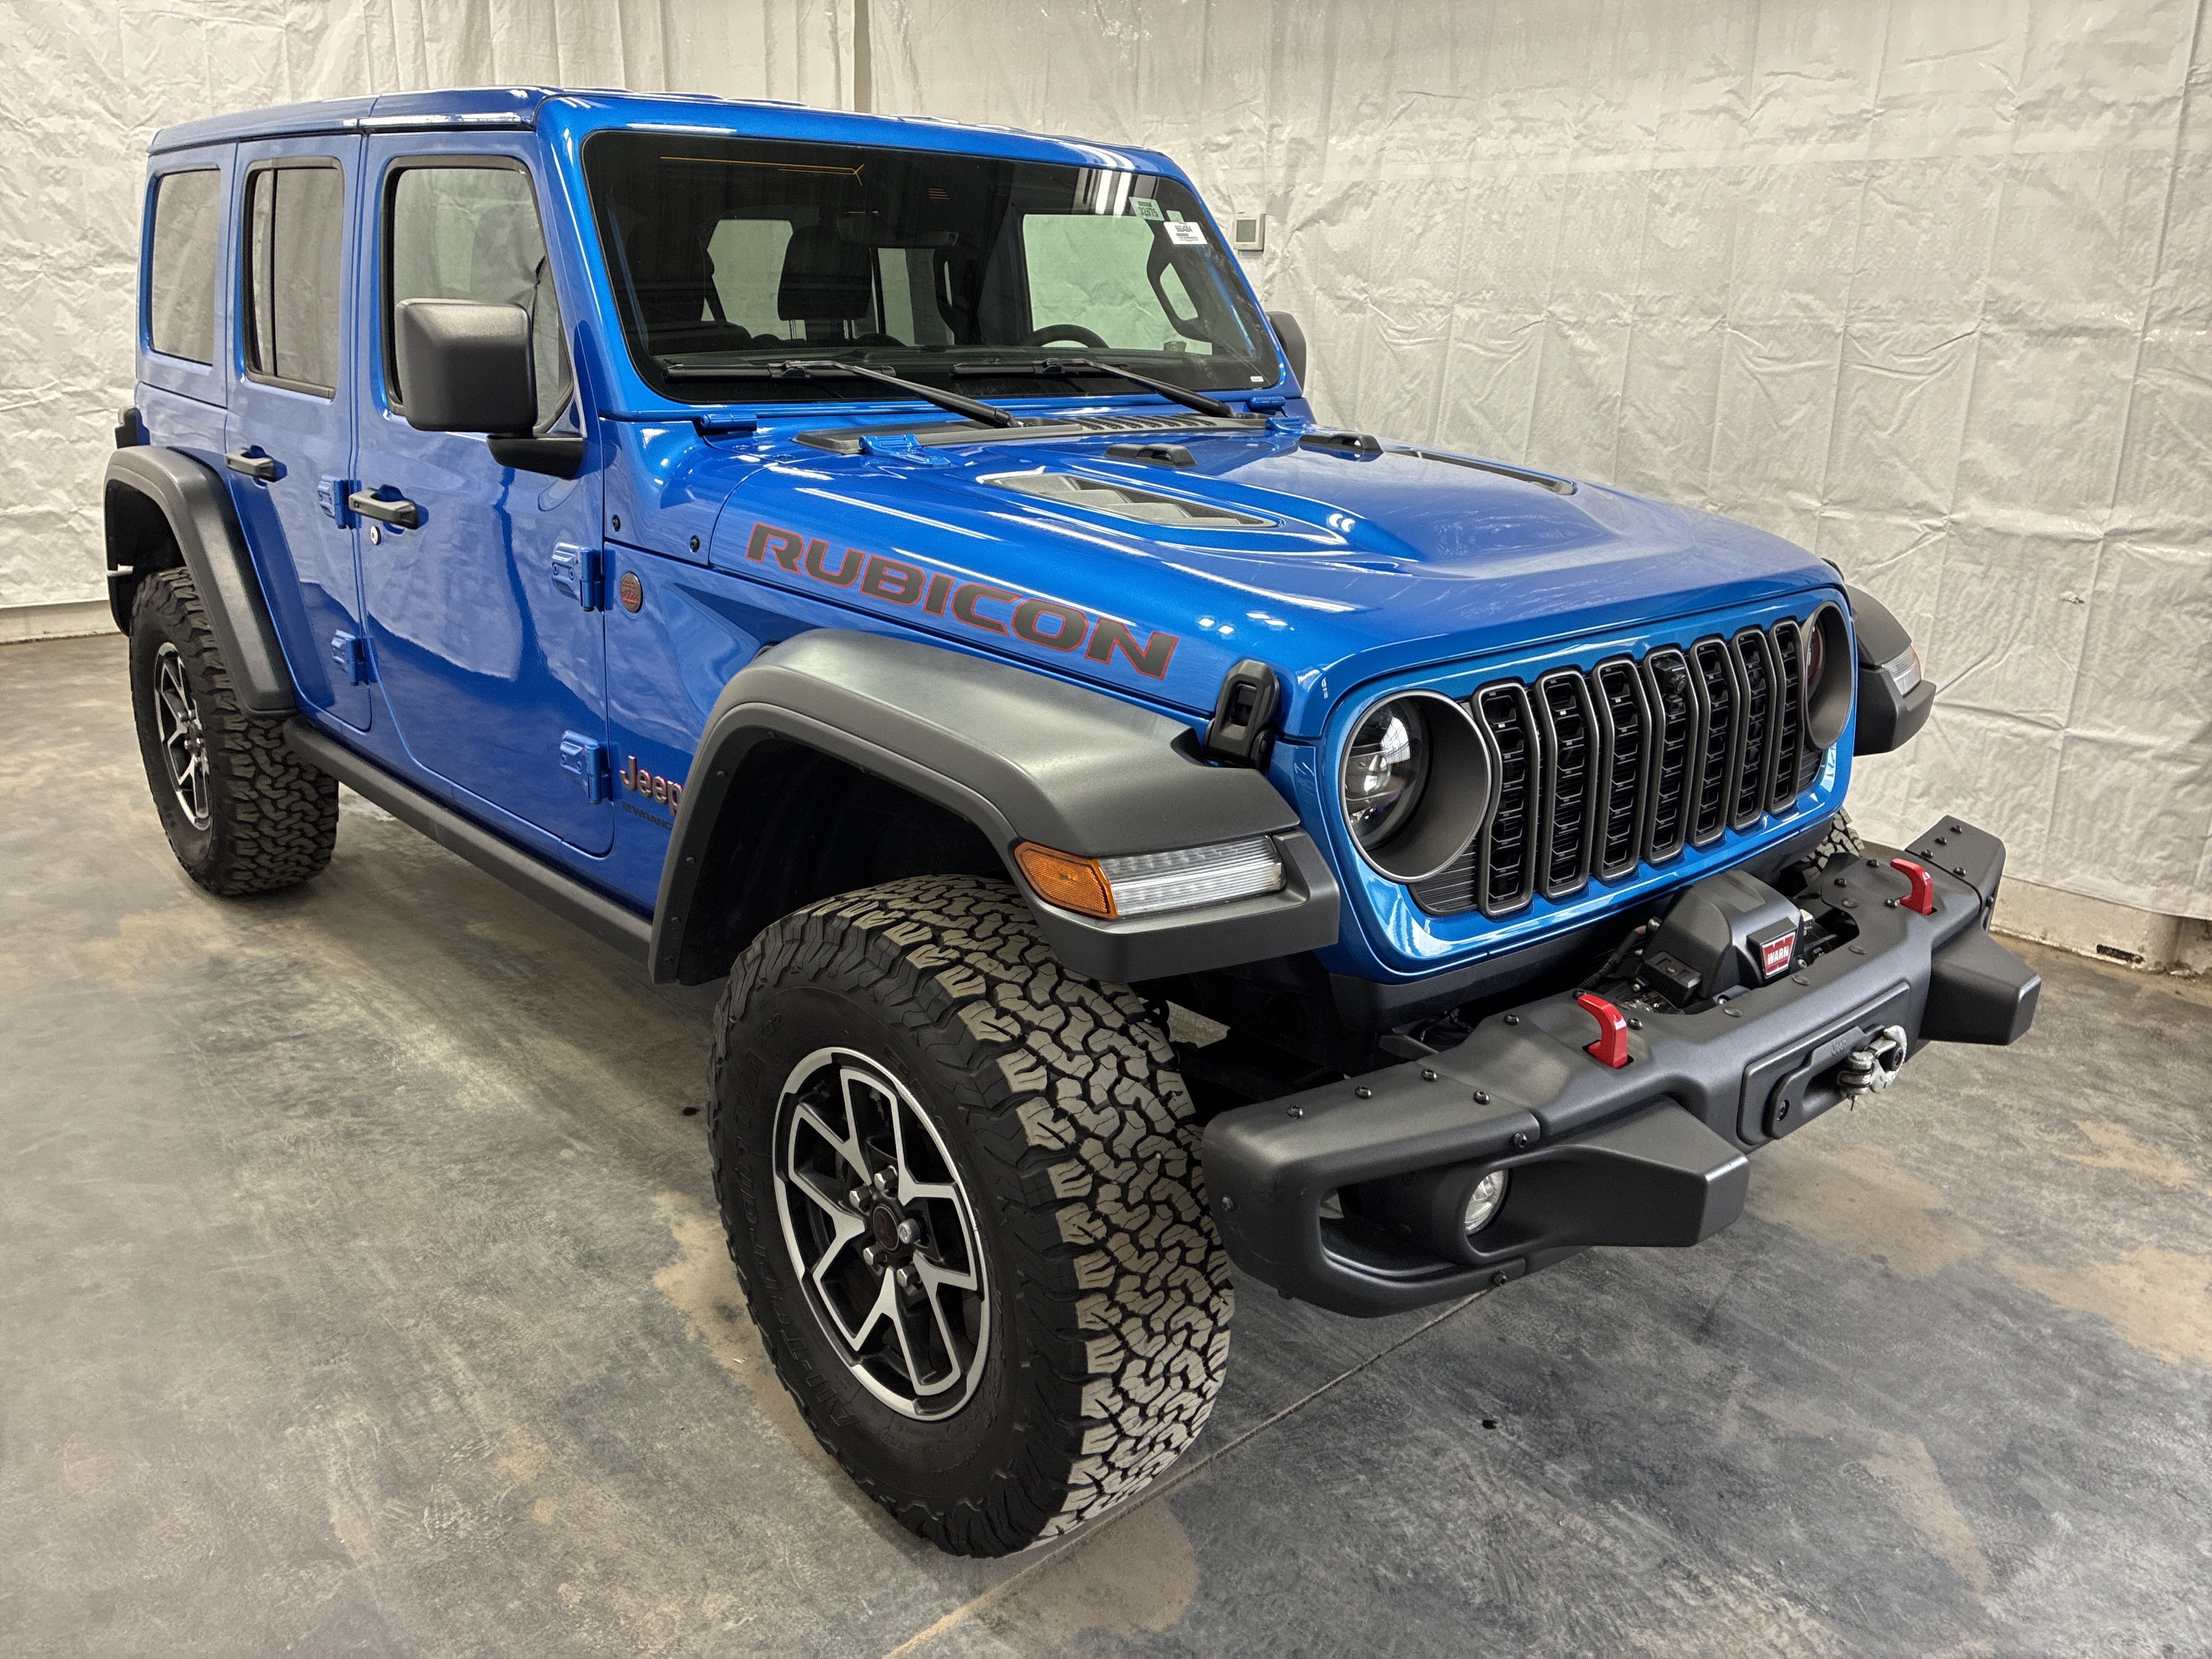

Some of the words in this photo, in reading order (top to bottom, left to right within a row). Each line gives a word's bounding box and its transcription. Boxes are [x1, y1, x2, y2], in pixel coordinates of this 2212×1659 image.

[746, 522, 1180, 681] RUBICON
[619, 755, 684, 817] Jeep
[1767, 945, 1790, 964] WARN
